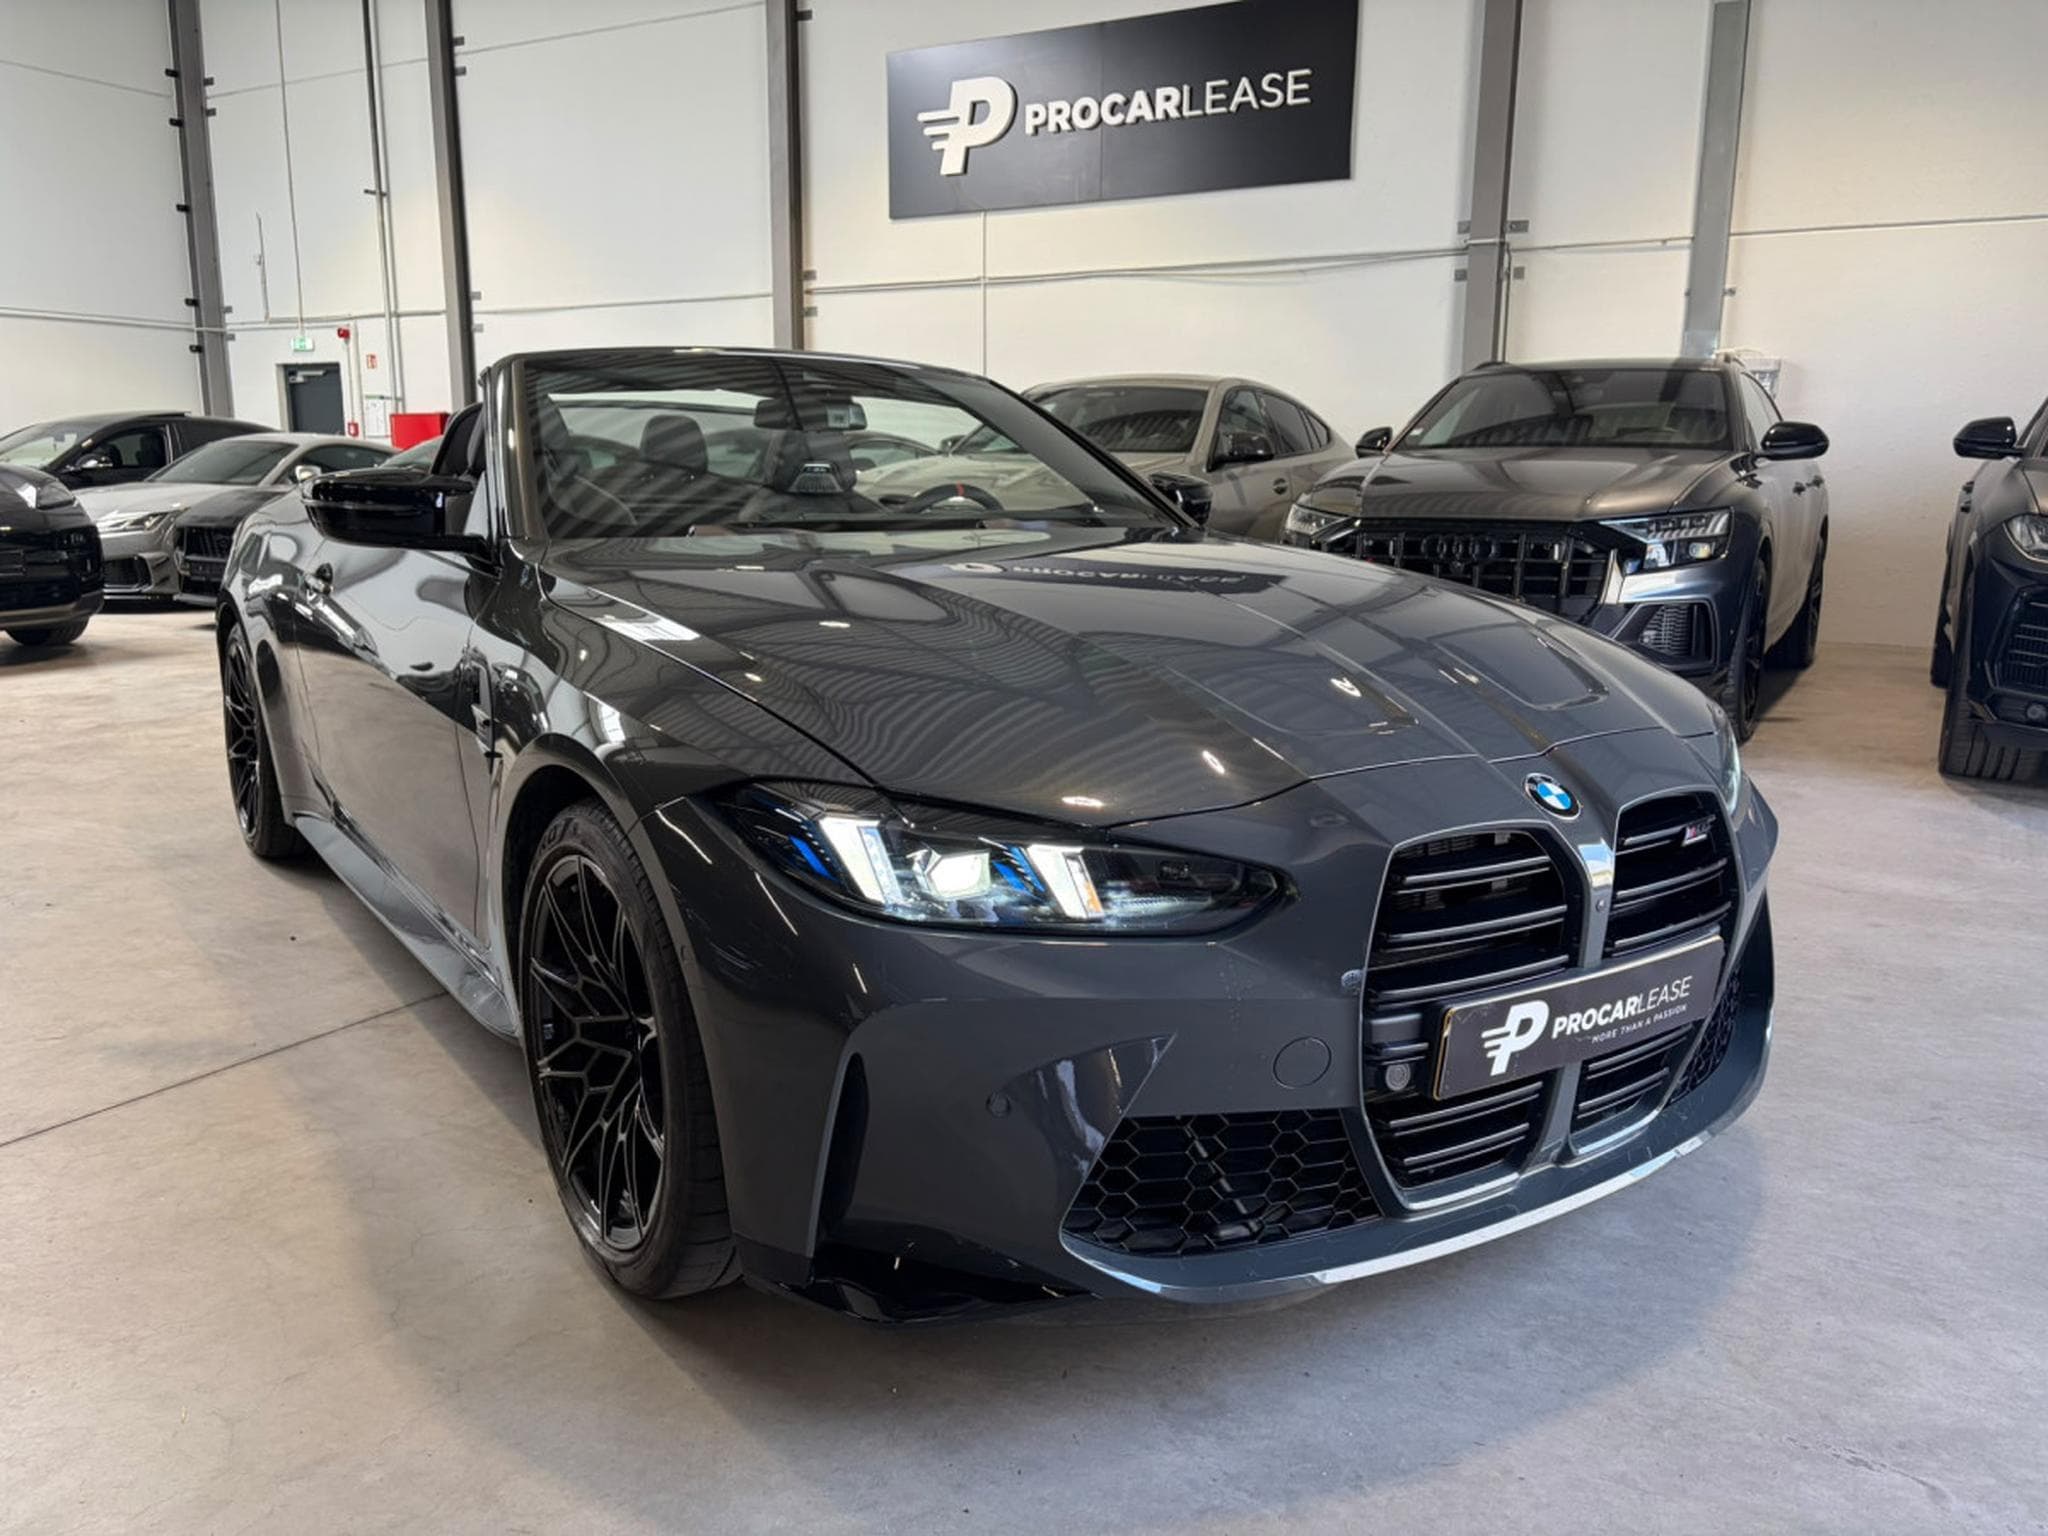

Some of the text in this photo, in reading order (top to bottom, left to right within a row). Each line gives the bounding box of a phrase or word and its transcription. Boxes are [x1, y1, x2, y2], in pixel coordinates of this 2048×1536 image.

[1025, 69, 1312, 136] PROCARLEASE
[1551, 975, 1693, 1040] PROCARLEASE
[1591, 1028, 1618, 1044] MORE
[1620, 1020, 1644, 1035] THAN
[1653, 1003, 1688, 1023] PASSION
